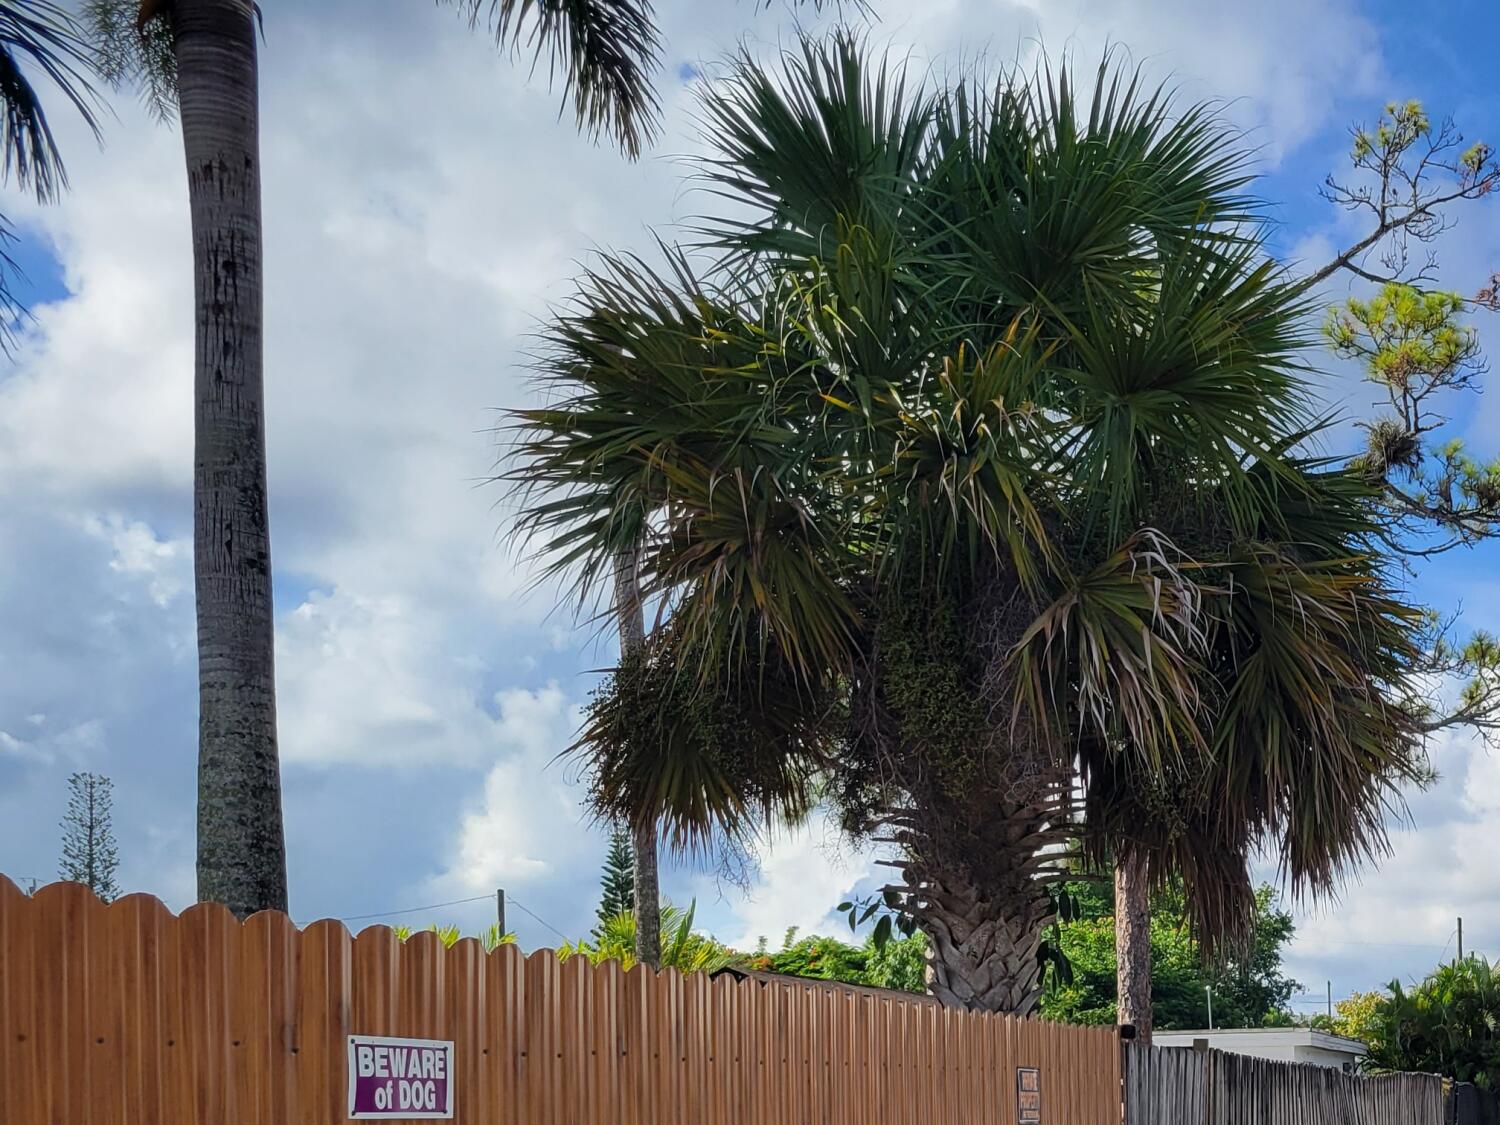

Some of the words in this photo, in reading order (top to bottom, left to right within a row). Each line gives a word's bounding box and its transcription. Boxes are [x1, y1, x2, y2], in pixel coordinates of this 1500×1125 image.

[357, 1046, 446, 1079] BEWARE
[375, 1080, 393, 1110] of
[399, 1080, 436, 1110] DOG
